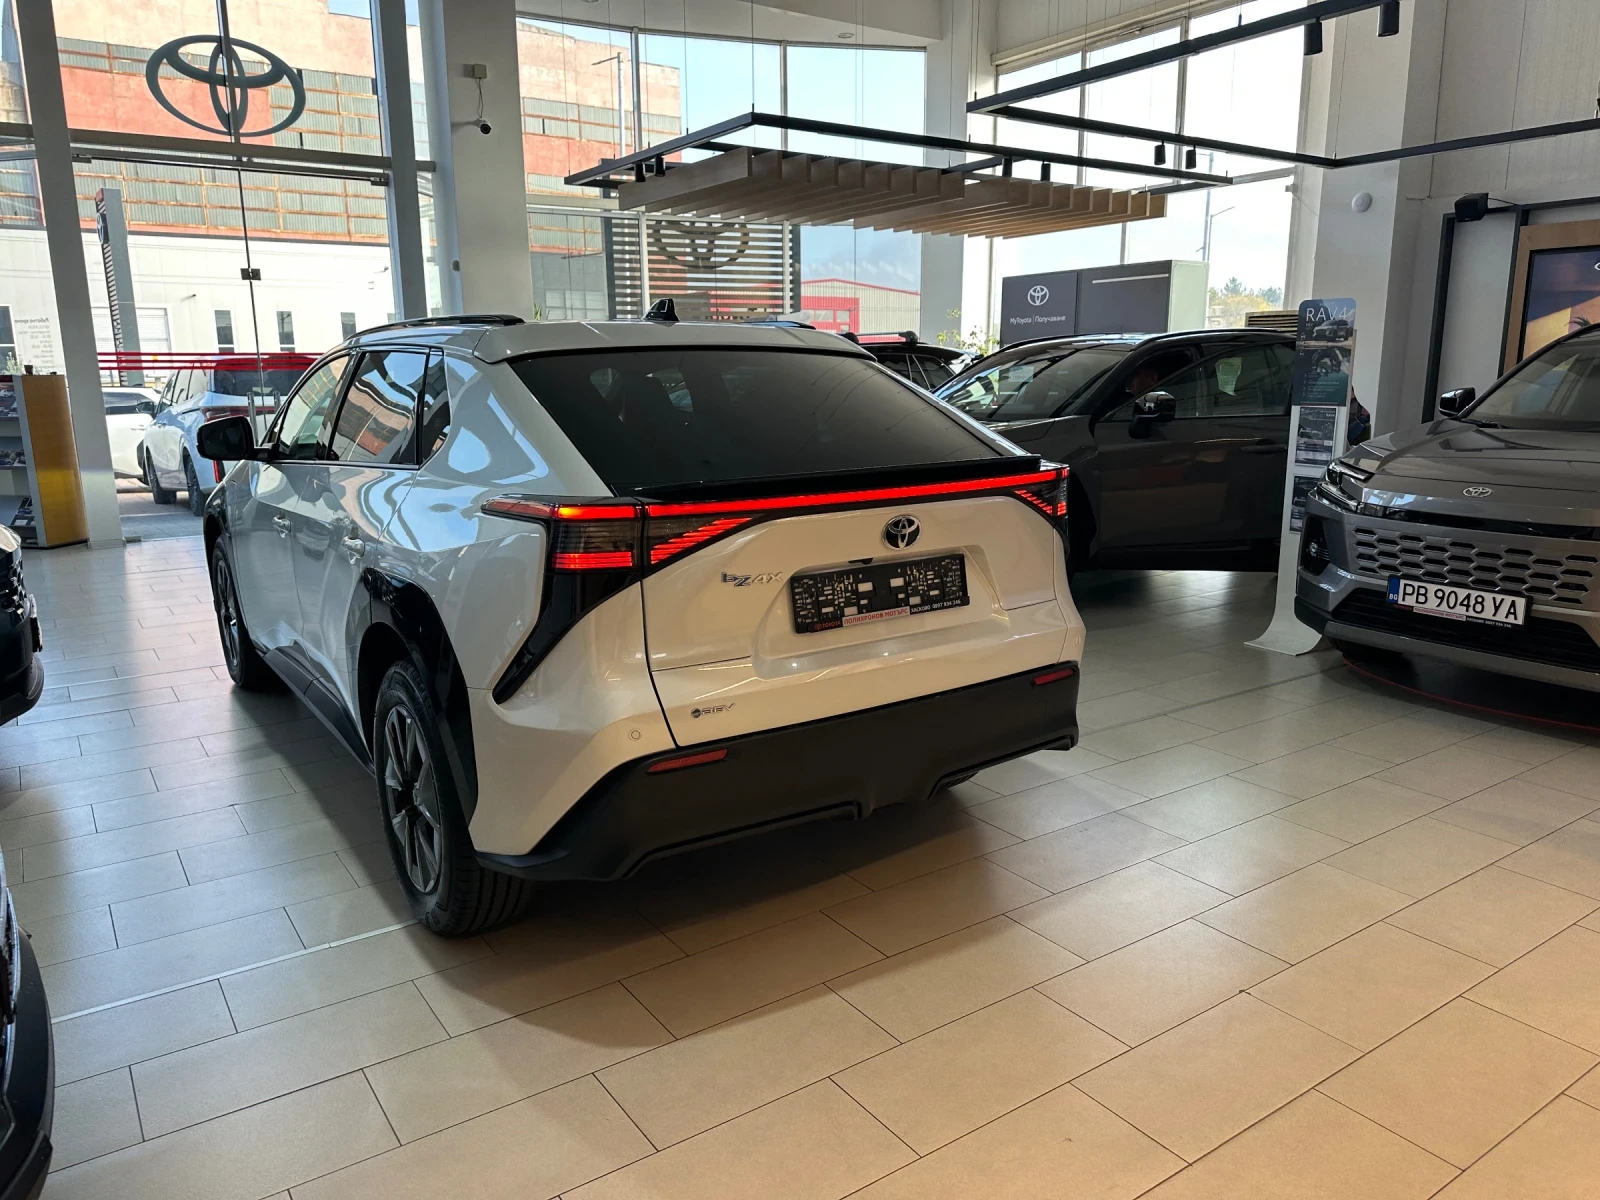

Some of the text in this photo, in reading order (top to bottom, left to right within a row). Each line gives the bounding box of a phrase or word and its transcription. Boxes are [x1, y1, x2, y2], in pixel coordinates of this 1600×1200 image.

[1010, 315, 1066, 325] MyToyota Получаване
[1306, 307, 1347, 321] RAV4
[1401, 583, 1518, 620] PB 9048 YA
[844, 613, 884, 625] ПОЛИХРОНОВ
[885, 608, 908, 617] МОТЪРС
